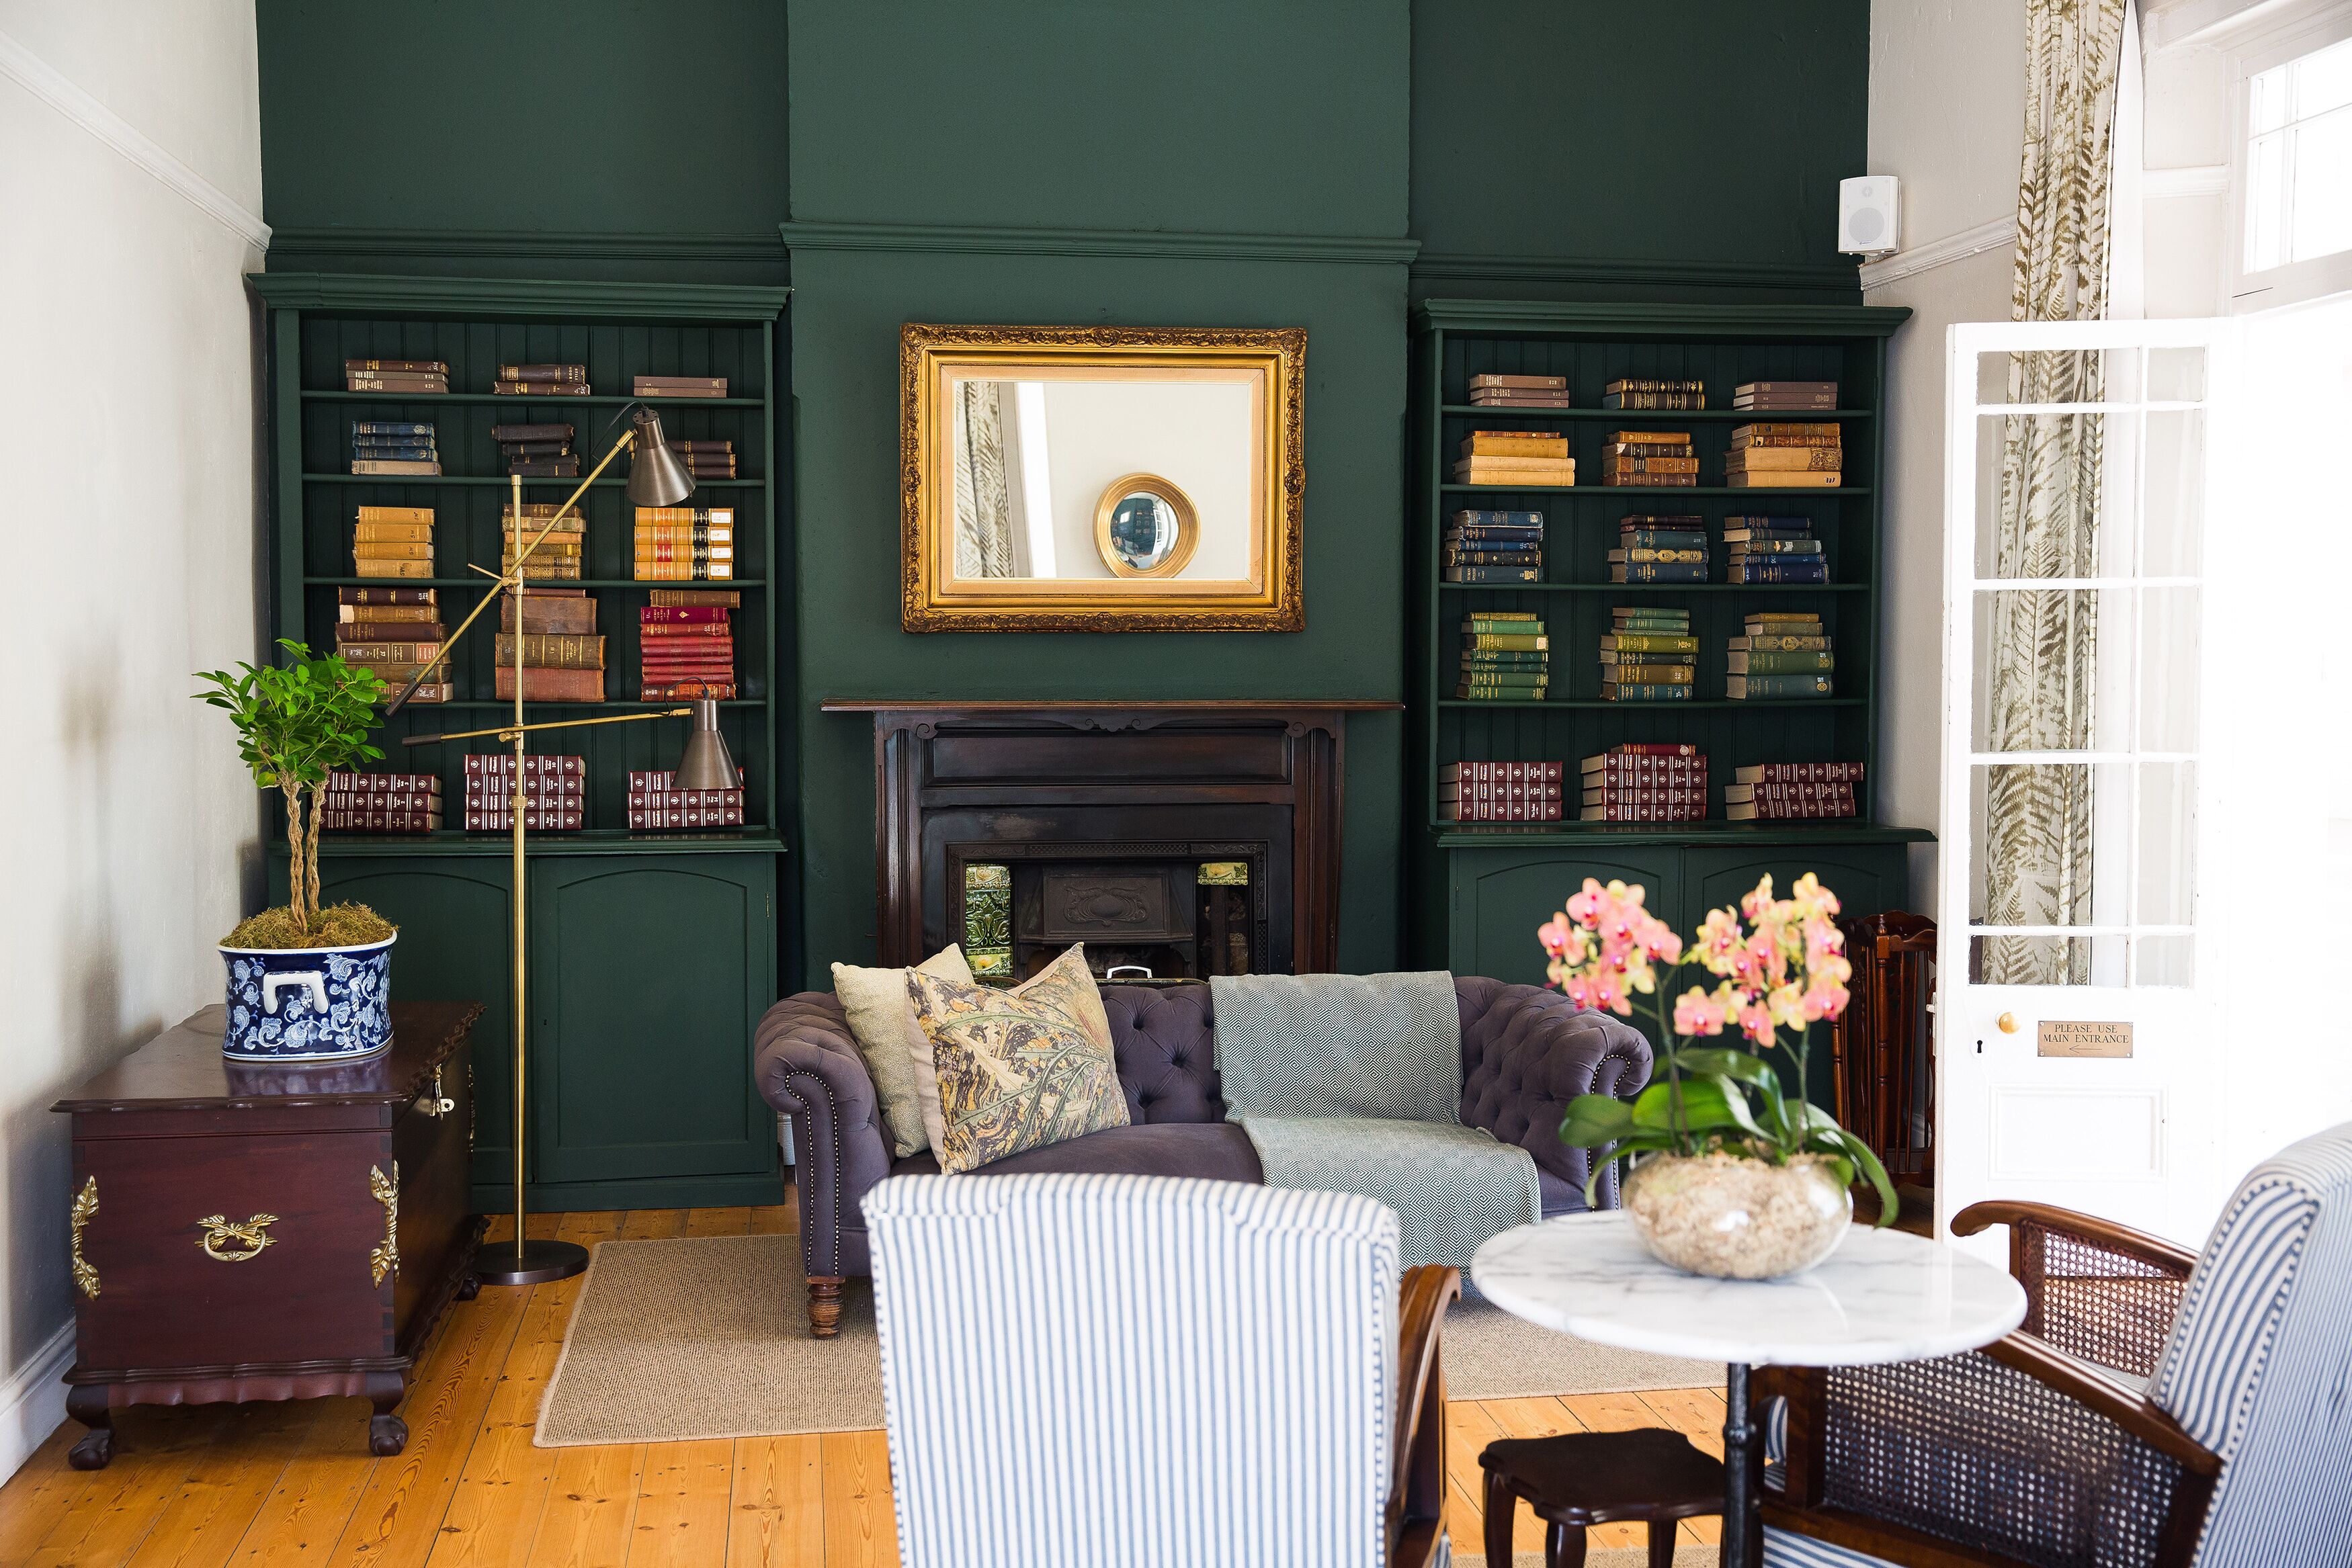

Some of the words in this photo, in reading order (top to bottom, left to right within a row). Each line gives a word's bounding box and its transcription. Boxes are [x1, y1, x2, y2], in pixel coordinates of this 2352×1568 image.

[411, 530, 415, 538] SW
[409, 547, 413, 555] SW
[2055, 1025, 2092, 1033] PLEASE
[2099, 1025, 2117, 1033] USE
[2044, 1034, 2069, 1043] MAIN
[2075, 1035, 2129, 1043] ENTRANCE
